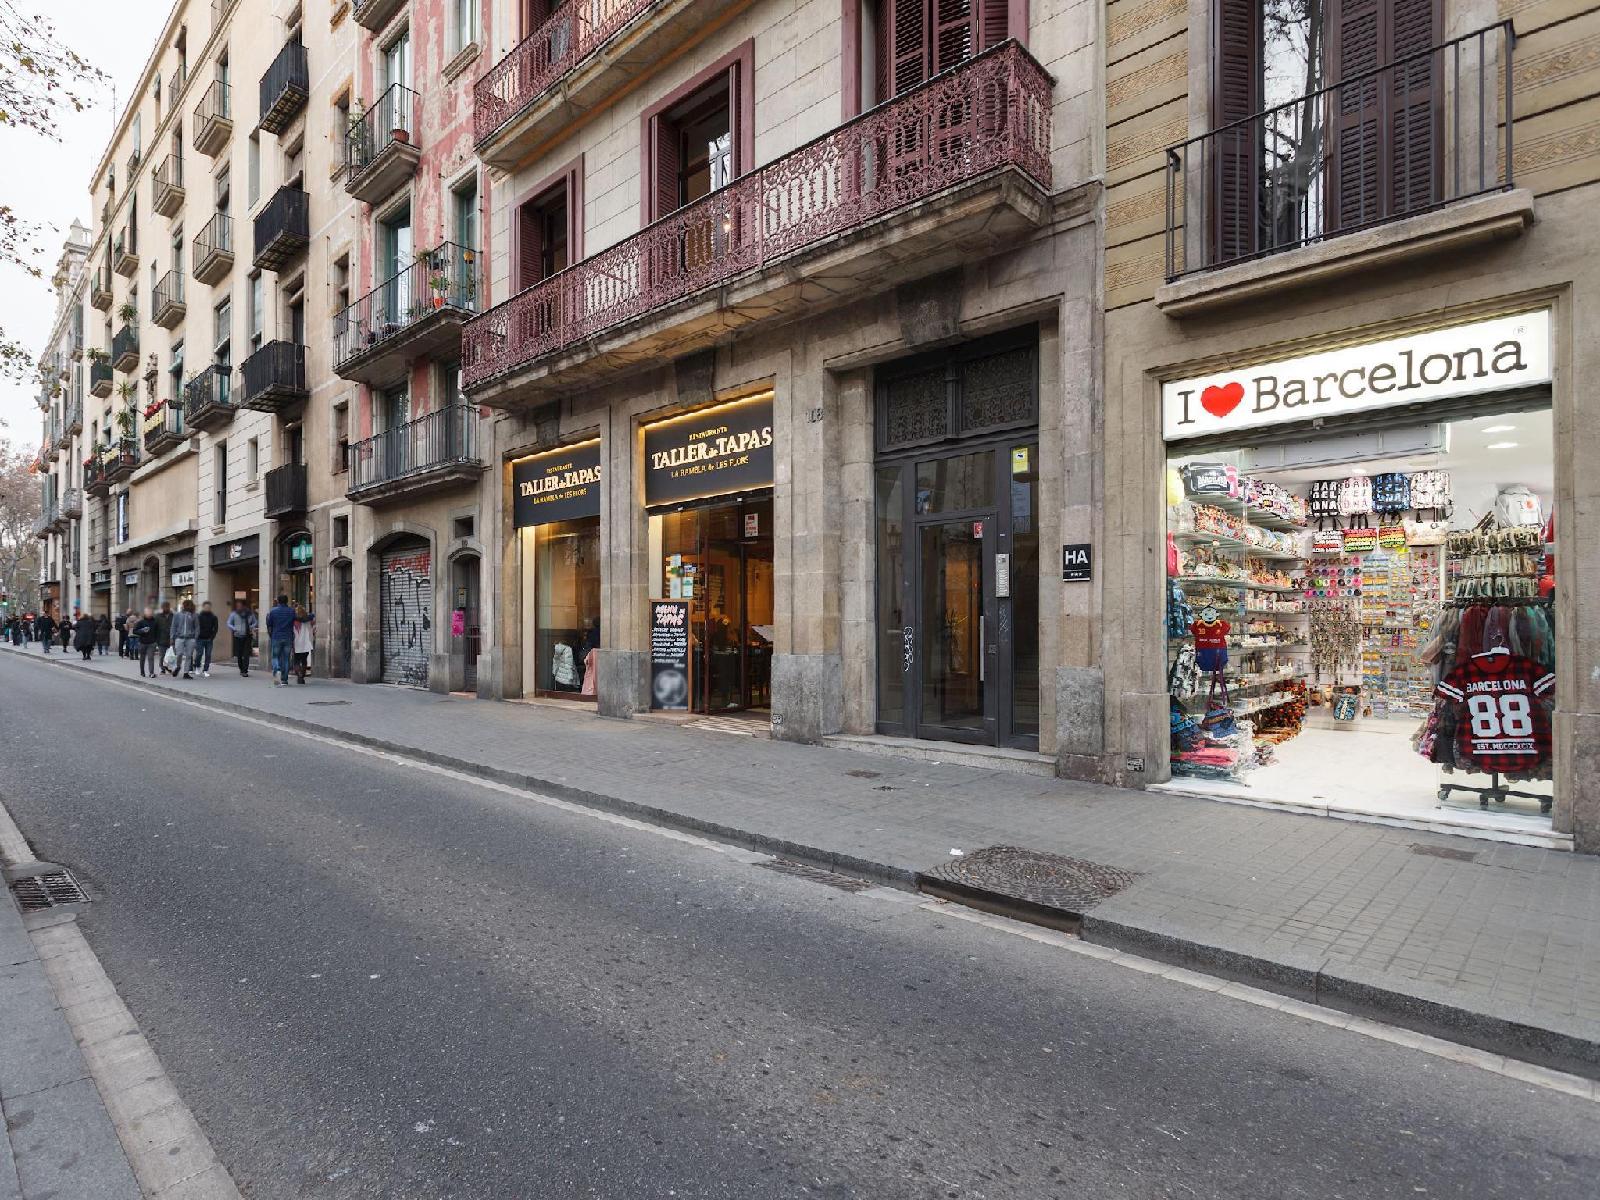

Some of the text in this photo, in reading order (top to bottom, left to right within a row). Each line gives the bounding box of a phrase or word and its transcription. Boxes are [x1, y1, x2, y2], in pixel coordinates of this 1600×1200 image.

[1177, 340, 1527, 424] I Barcelona
[651, 442, 710, 470] TALLER
[716, 426, 773, 456] TAPAS
[520, 475, 560, 497] TALLER
[564, 465, 601, 488] TAPAS
[671, 470, 679, 478] LA
[680, 465, 707, 477] RAMBLA
[716, 461, 728, 470] LES
[1065, 550, 1089, 565] HA
[1466, 679, 1527, 693] BARCELONA
[1467, 694, 1533, 738] 88
